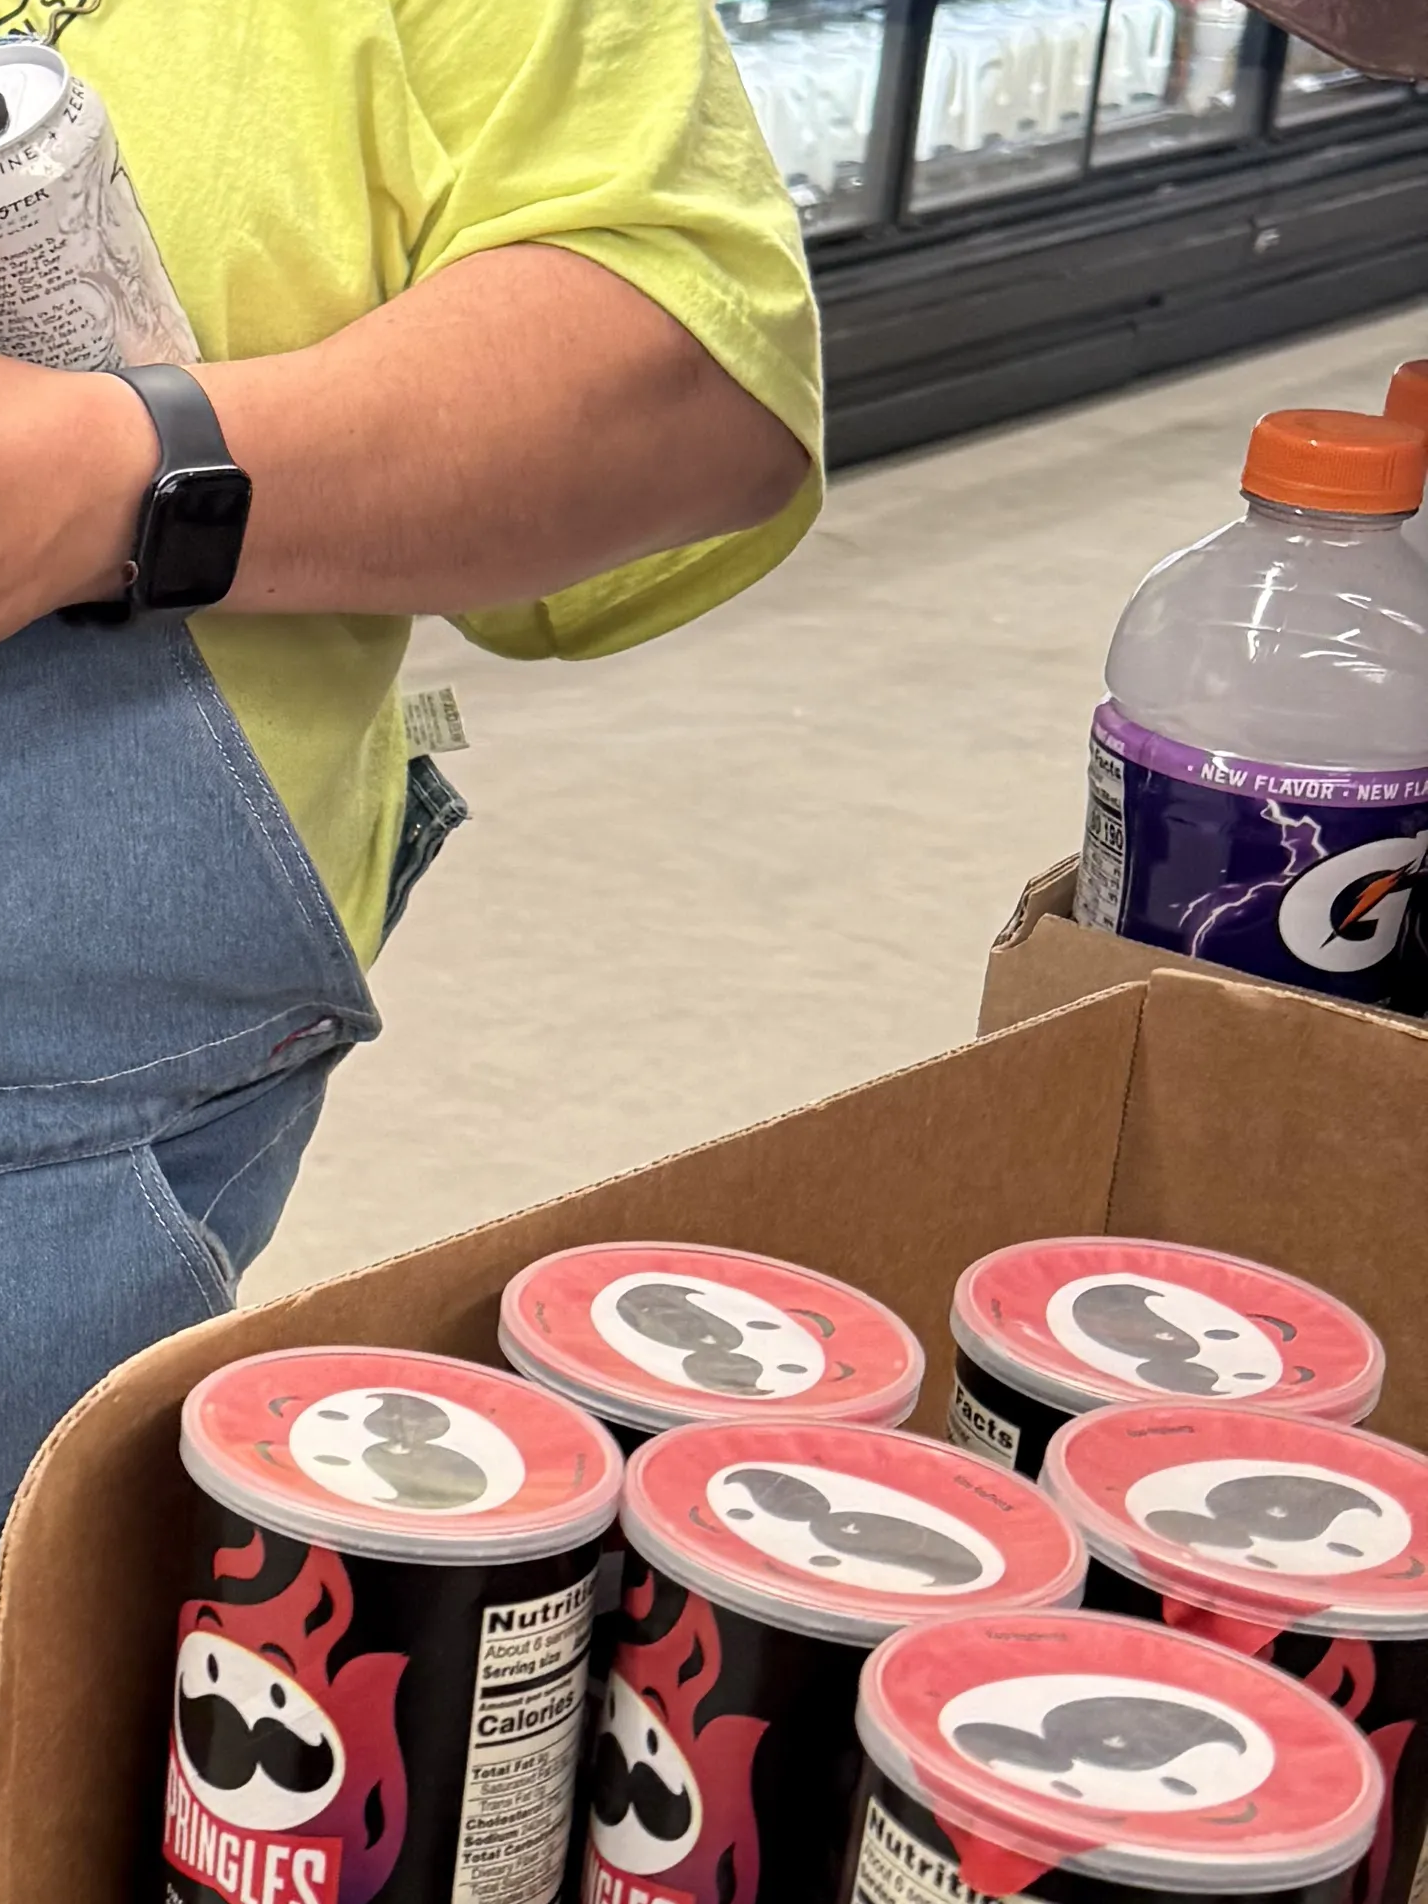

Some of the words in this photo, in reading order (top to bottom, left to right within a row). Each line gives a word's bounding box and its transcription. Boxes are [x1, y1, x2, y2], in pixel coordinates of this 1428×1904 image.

[1200, 763, 1248, 787] NEW
[1254, 775, 1334, 800] FLAVOR
[1356, 783, 1399, 802] NEW
[955, 1384, 1014, 1450] Facts
[484, 1640, 531, 1661] About
[482, 1659, 536, 1682] Serving
[476, 1690, 574, 1737] Calories
